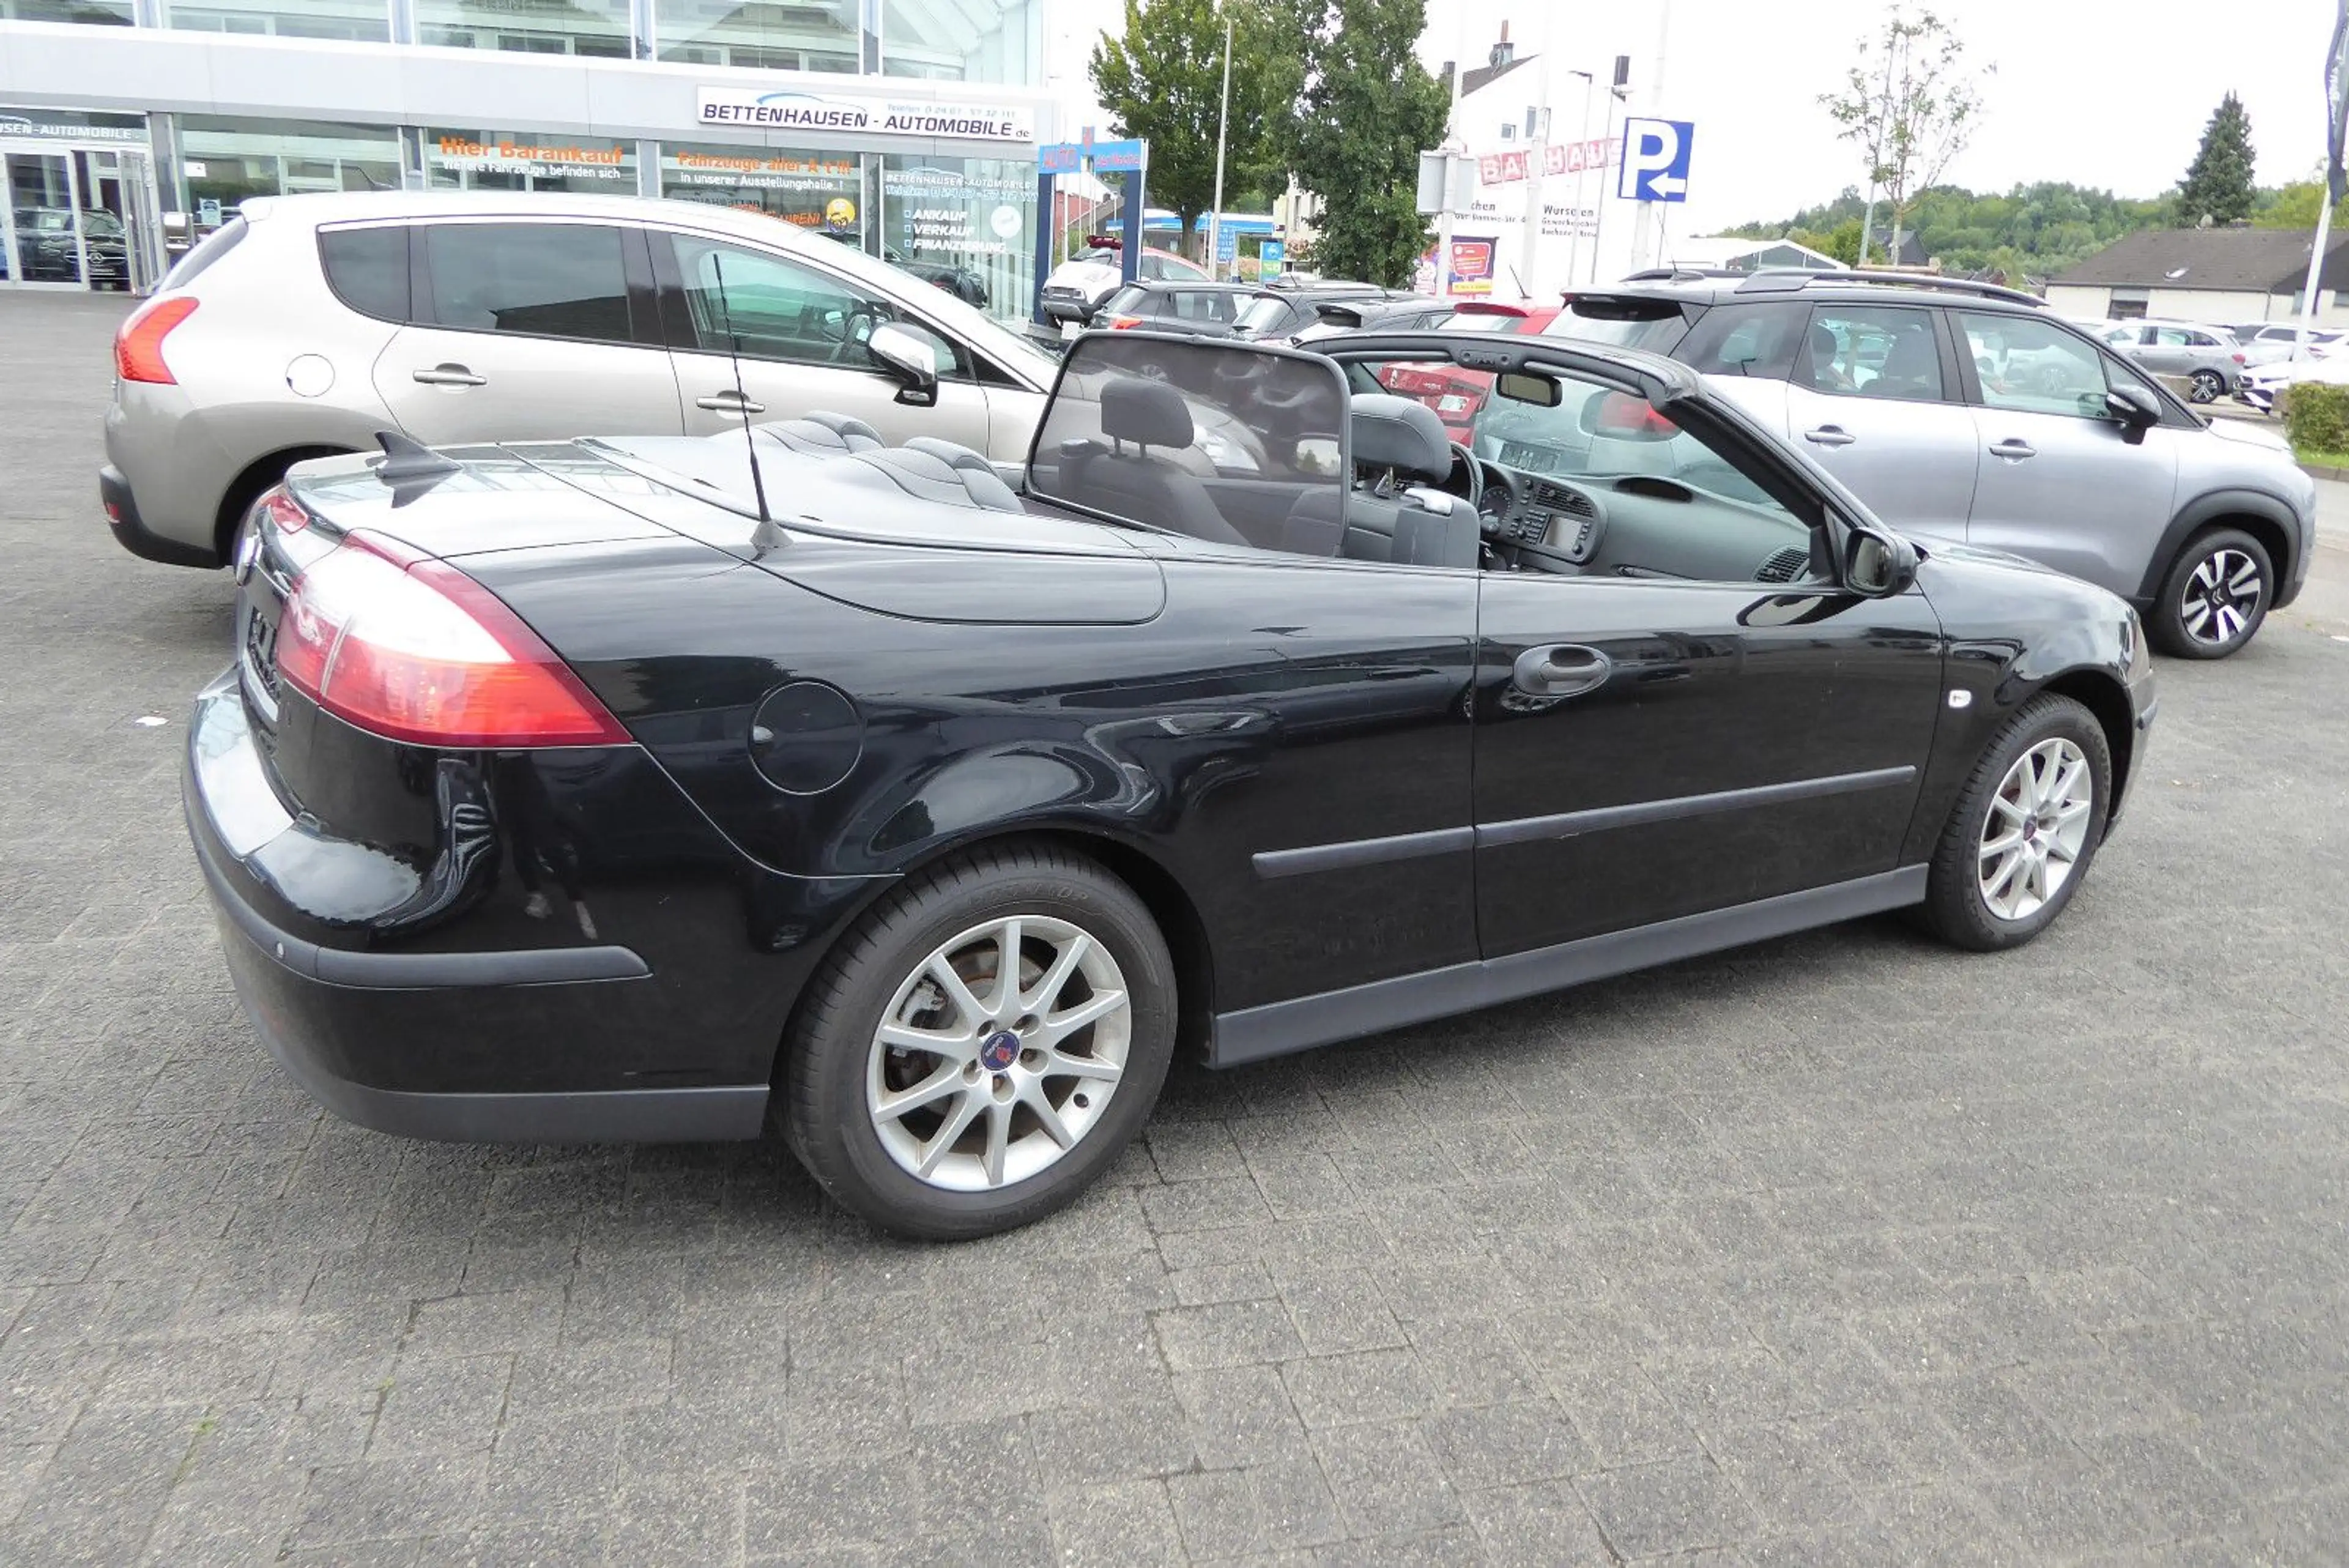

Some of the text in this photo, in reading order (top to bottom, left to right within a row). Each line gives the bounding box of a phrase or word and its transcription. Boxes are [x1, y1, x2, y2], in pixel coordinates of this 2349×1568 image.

[703, 103, 868, 127] BETTENHAUSEN
[884, 115, 1012, 136] AUTOMOBILE
[440, 136, 623, 164] Hier Barankauf
[1622, 119, 1679, 198] P
[489, 161, 547, 177] Fahrzeuge
[551, 163, 596, 178] befinden
[598, 167, 621, 179] sich
[681, 172, 691, 183] in
[694, 174, 737, 185] unserer
[913, 209, 967, 221] ANKAUF
[913, 223, 974, 236] VERKAUF
[913, 238, 1006, 253] FINANZIERUNG
